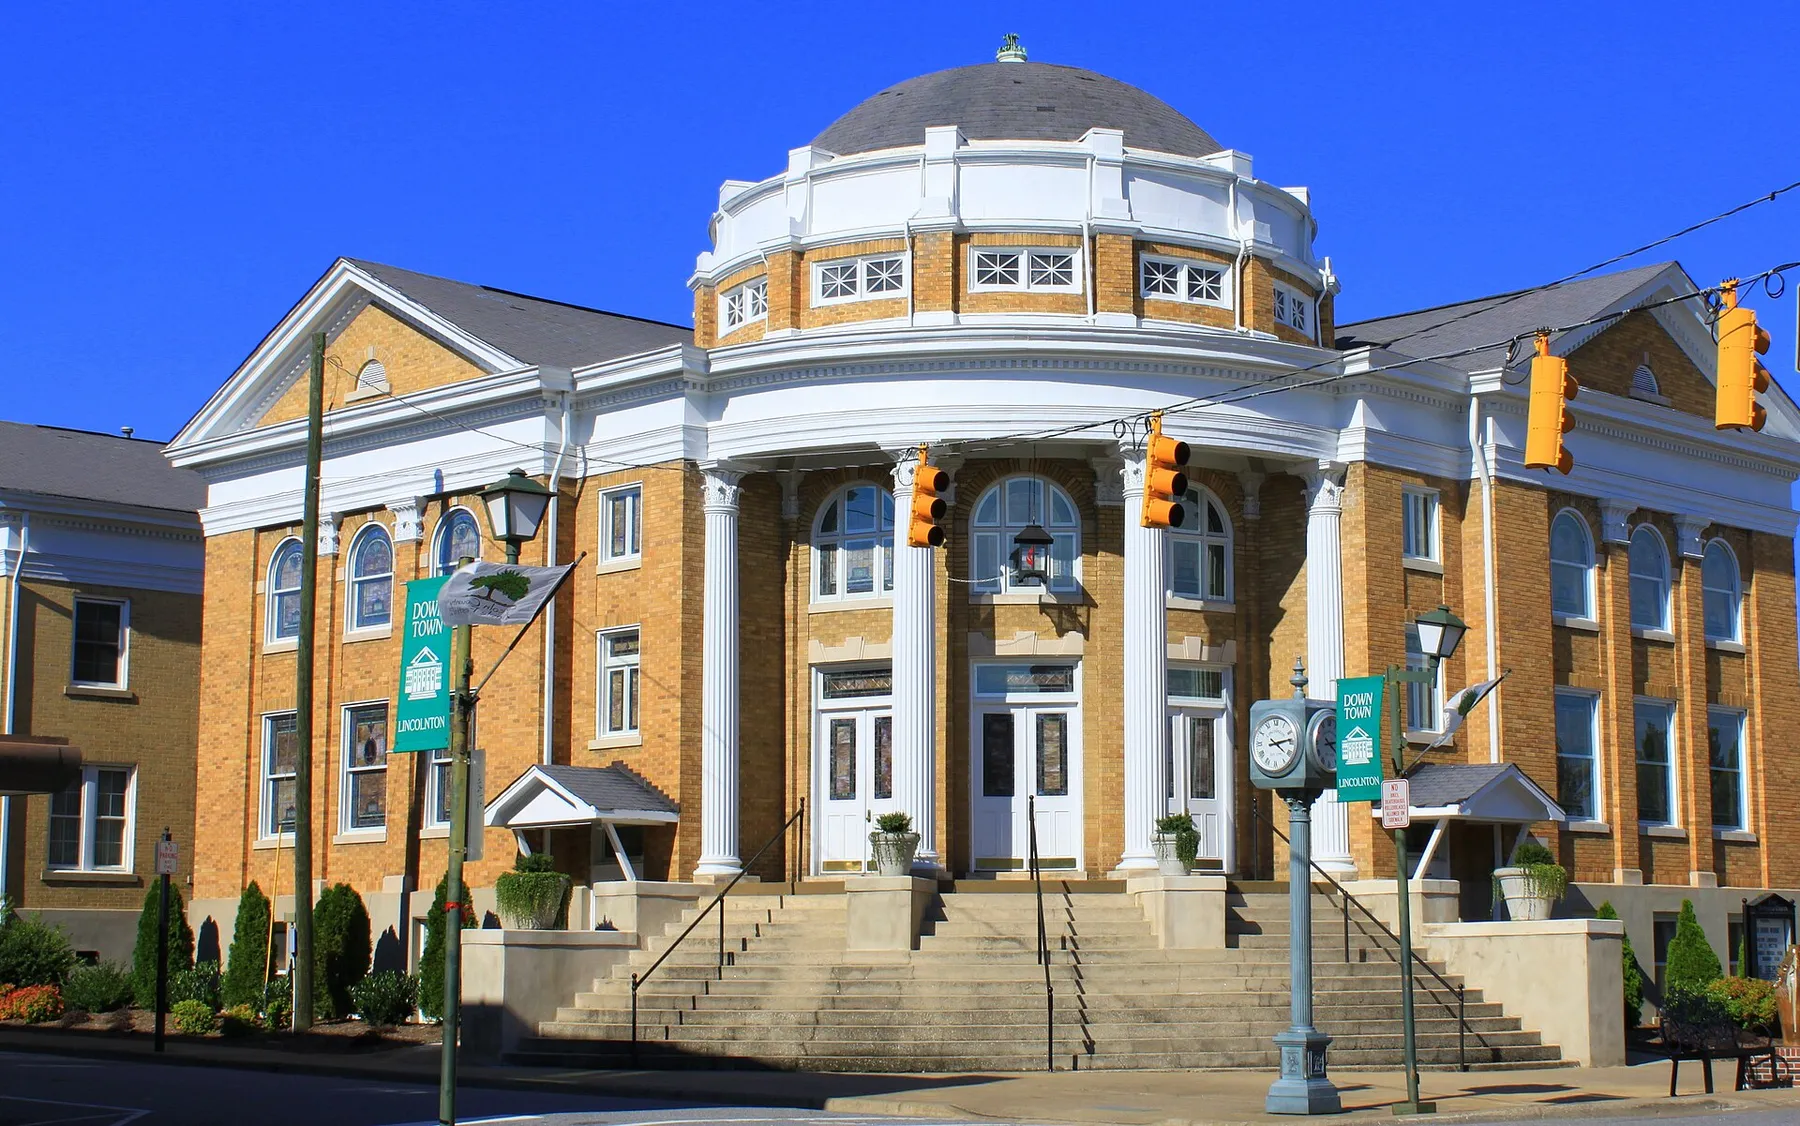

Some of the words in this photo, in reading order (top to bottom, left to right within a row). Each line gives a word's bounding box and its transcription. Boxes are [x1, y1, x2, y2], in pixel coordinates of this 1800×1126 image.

[412, 618, 443, 638] TOWN
[1343, 692, 1373, 707] DOWN
[1343, 706, 1372, 720] TOWN
[397, 715, 446, 733] LINCOLNTON
[1338, 776, 1380, 788] LINCOLNTON
